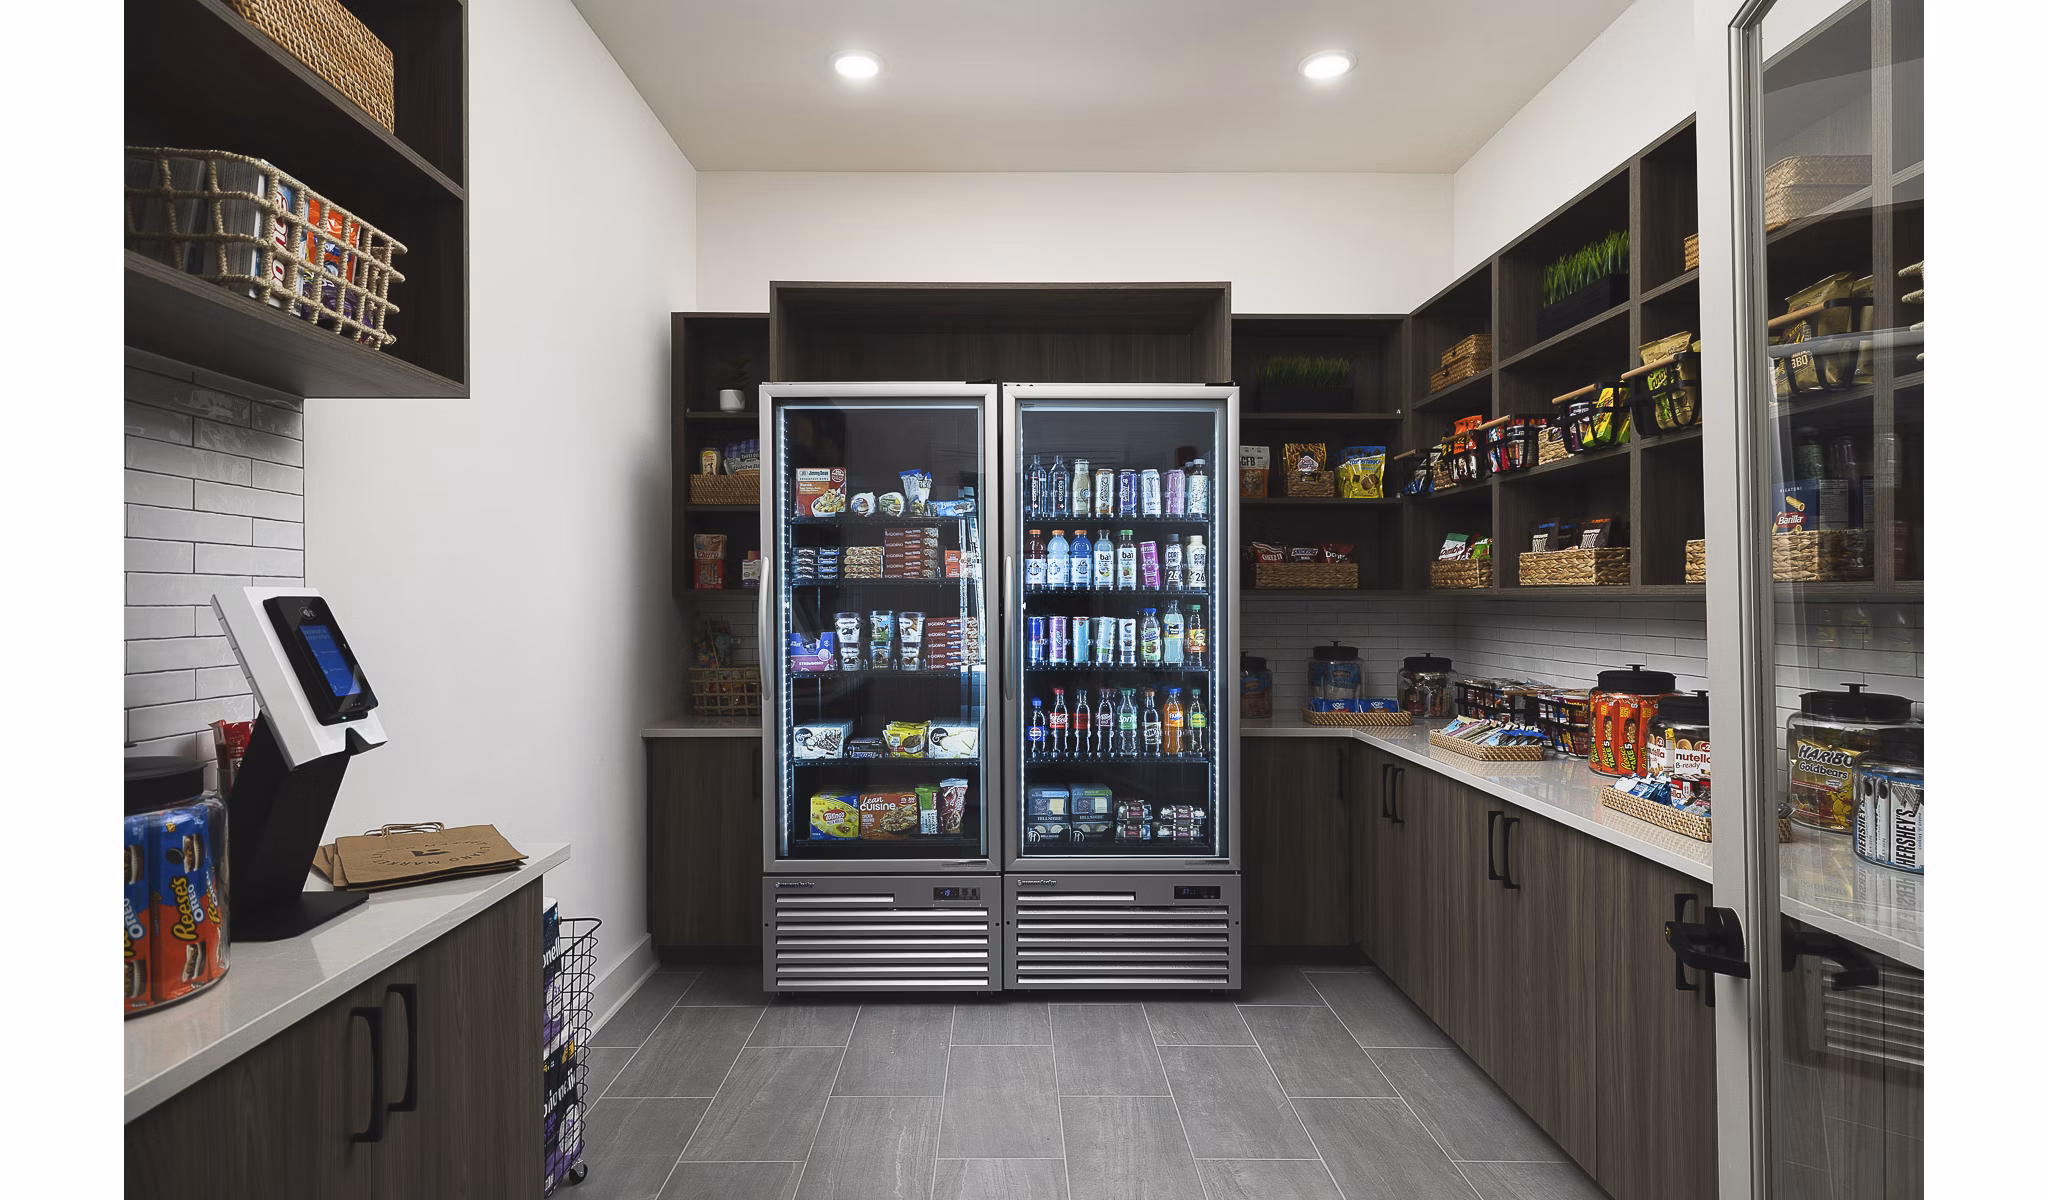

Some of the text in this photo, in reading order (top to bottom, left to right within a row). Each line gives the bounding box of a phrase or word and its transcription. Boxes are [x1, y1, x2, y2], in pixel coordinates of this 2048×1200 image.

[1777, 514, 1804, 525] Barilla
[1100, 552, 1111, 561] bai
[1121, 550, 1134, 559] bai
[1168, 570, 1179, 580] 26
[1195, 572, 1205, 582] 26
[1626, 749, 1637, 771] TAKE
[1798, 745, 1853, 768] HARIBO
[1799, 761, 1848, 779] Goldbears
[862, 796, 884, 805] Lean
[1895, 808, 1917, 869] HERSHEY'S
[171, 875, 198, 941] Reese's
[188, 884, 204, 923] OREO
